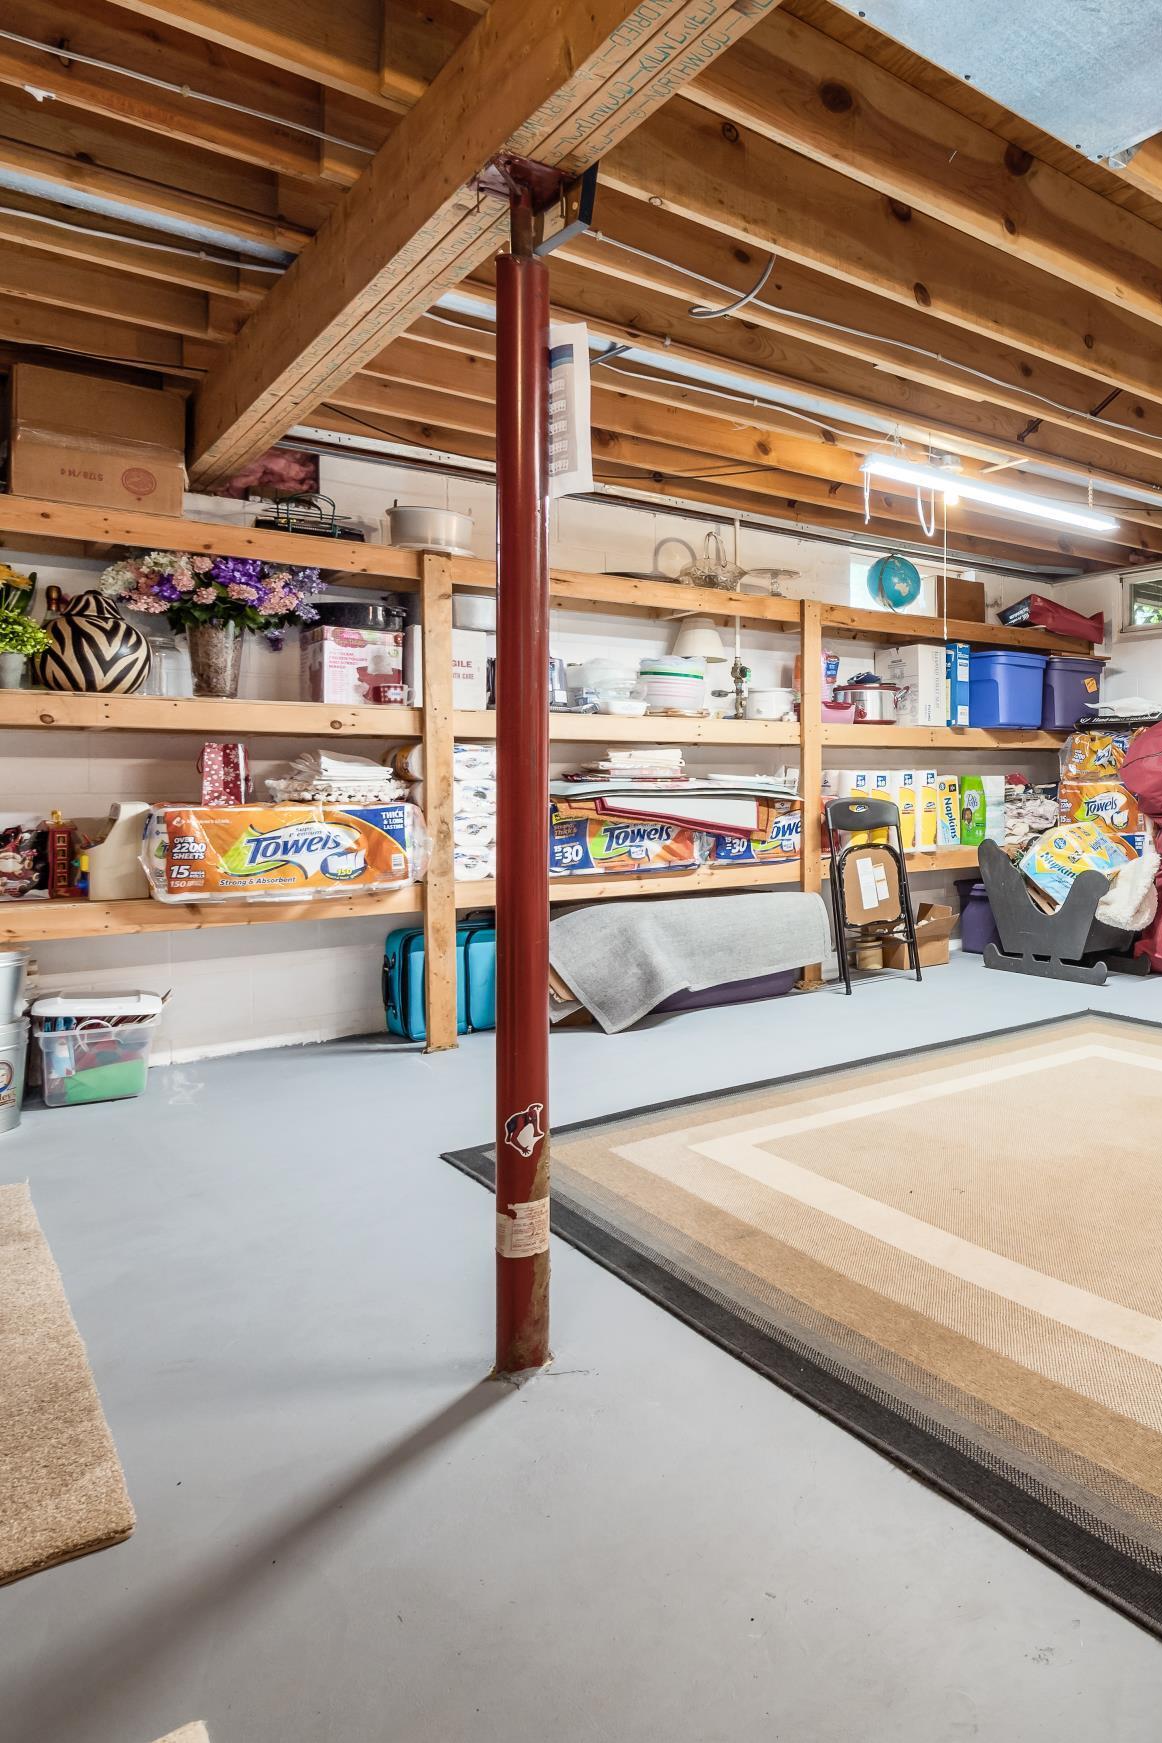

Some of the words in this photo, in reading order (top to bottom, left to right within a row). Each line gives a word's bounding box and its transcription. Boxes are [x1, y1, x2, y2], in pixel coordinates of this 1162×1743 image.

[1084, 796, 1118, 817] Towels
[943, 797, 958, 839] Napkins
[172, 843, 207, 853] 2200
[246, 831, 341, 865] Towels
[603, 824, 673, 853] Towels
[170, 865, 191, 879] 15
[220, 879, 247, 887] Strong
